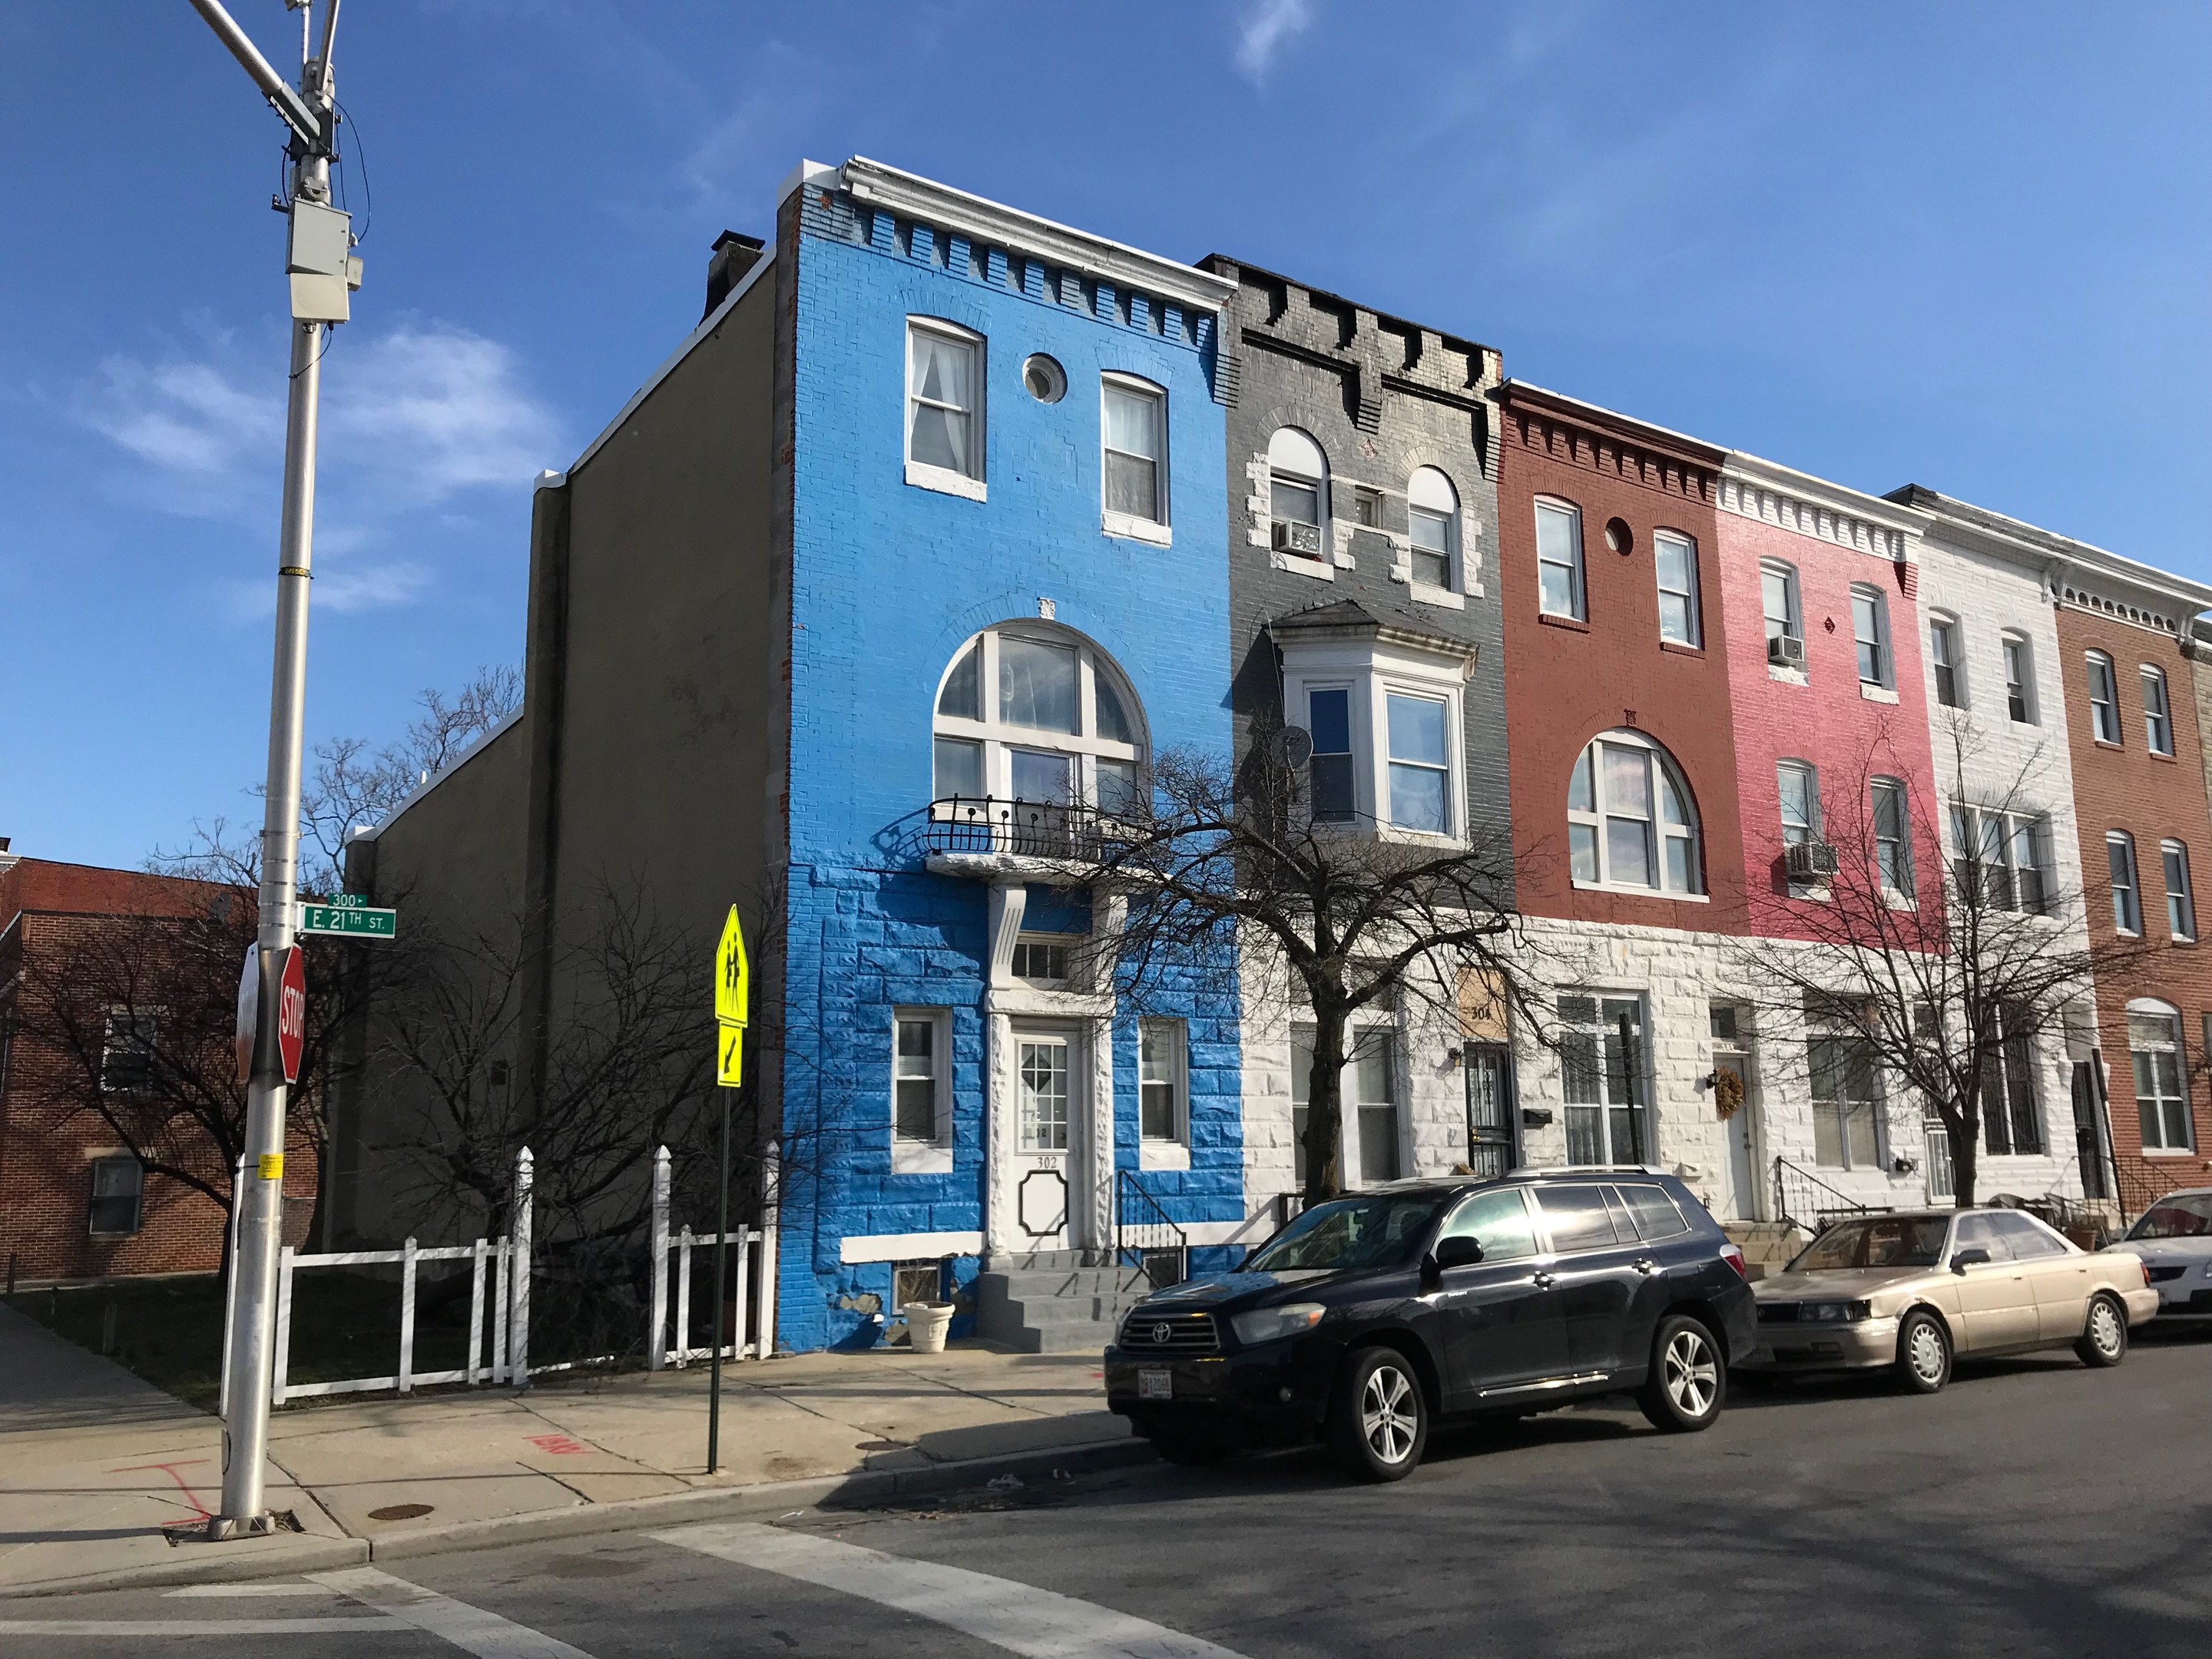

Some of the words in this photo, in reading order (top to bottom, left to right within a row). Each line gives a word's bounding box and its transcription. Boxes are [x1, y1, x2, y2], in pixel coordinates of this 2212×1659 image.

[333, 894, 356, 906] 300
[313, 909, 325, 929] E.
[369, 917, 385, 929] ST.
[282, 985, 304, 1039] STOP
[1038, 1157, 1057, 1169] 302
